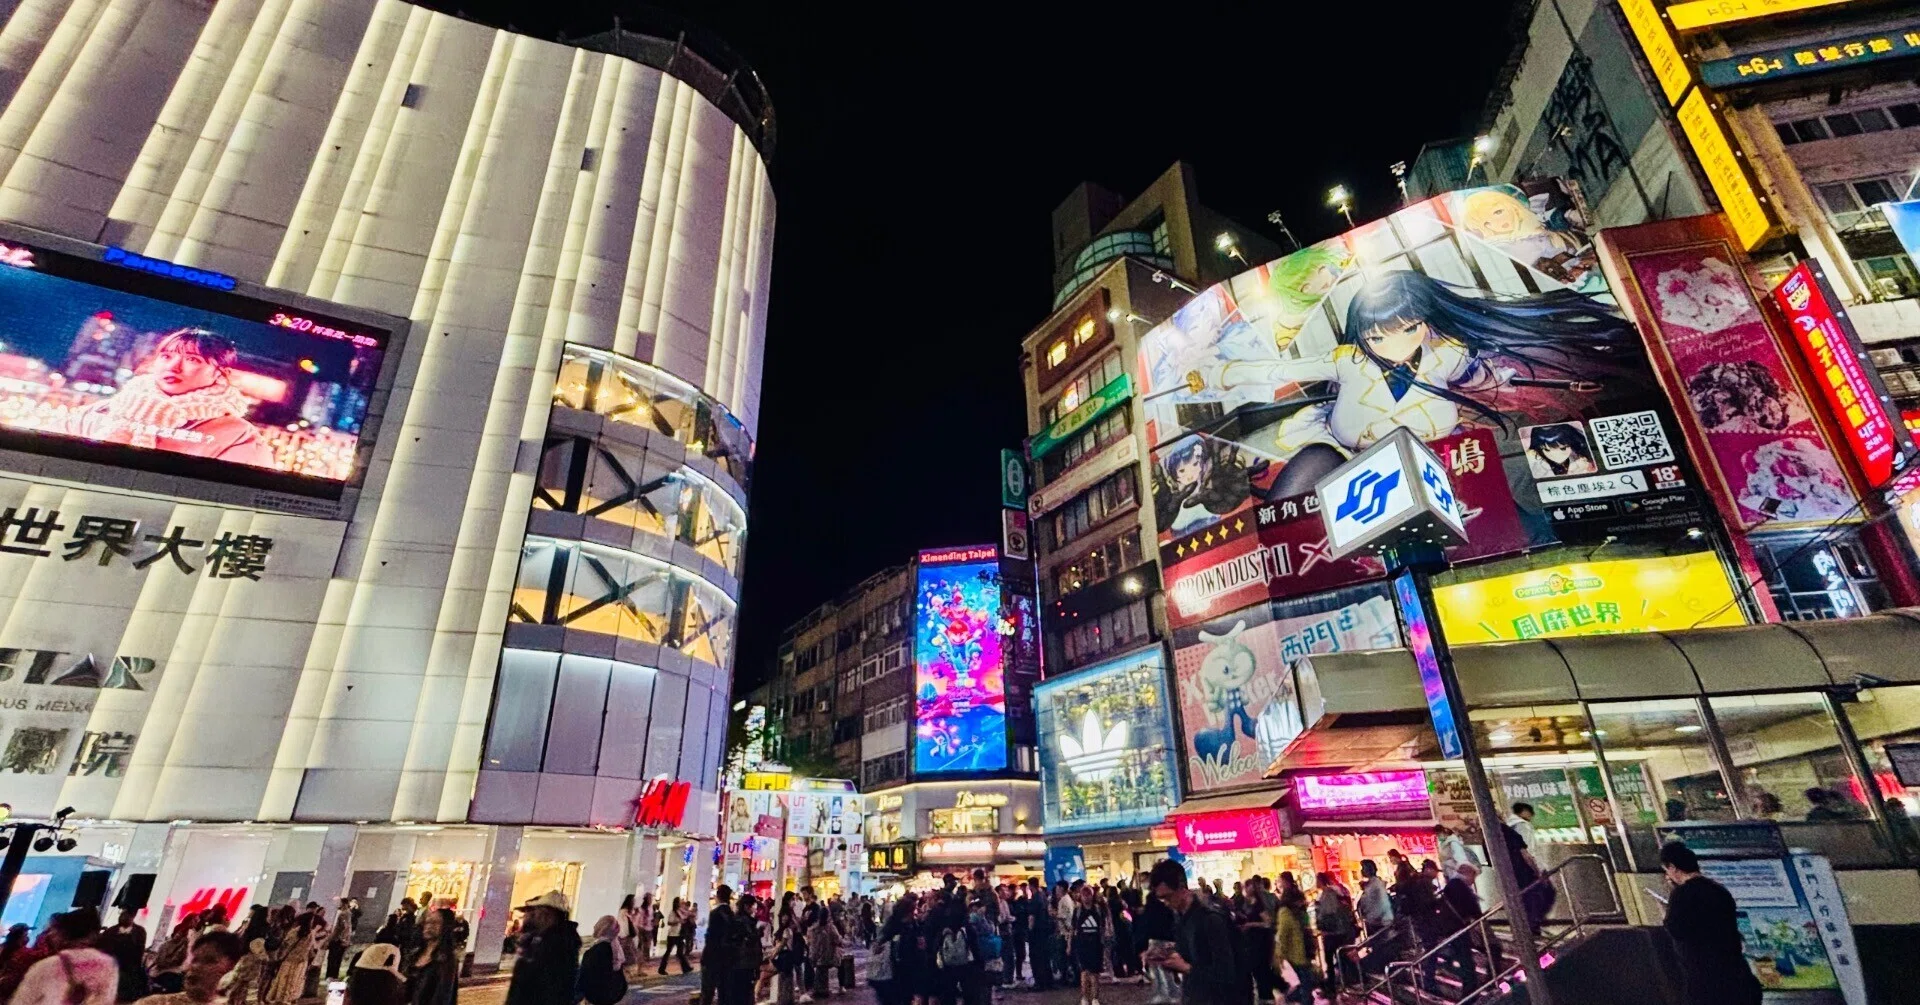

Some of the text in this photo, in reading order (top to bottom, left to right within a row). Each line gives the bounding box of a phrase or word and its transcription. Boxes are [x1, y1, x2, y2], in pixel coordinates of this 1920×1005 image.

[104, 247, 236, 290] Panasonic
[1547, 481, 1616, 496] 棕色塵埃2
[1641, 495, 1686, 506] Google Play
[1258, 495, 1321, 525] 新角色
[1567, 503, 1608, 515] App Store
[0, 507, 274, 582] 世界大樓
[920, 548, 996, 562] Ximending Taipei
[1229, 545, 1270, 587] DUST
[1512, 602, 1621, 640] 風靡世界
[728, 842, 741, 854] UT
[850, 843, 862, 854] UT
